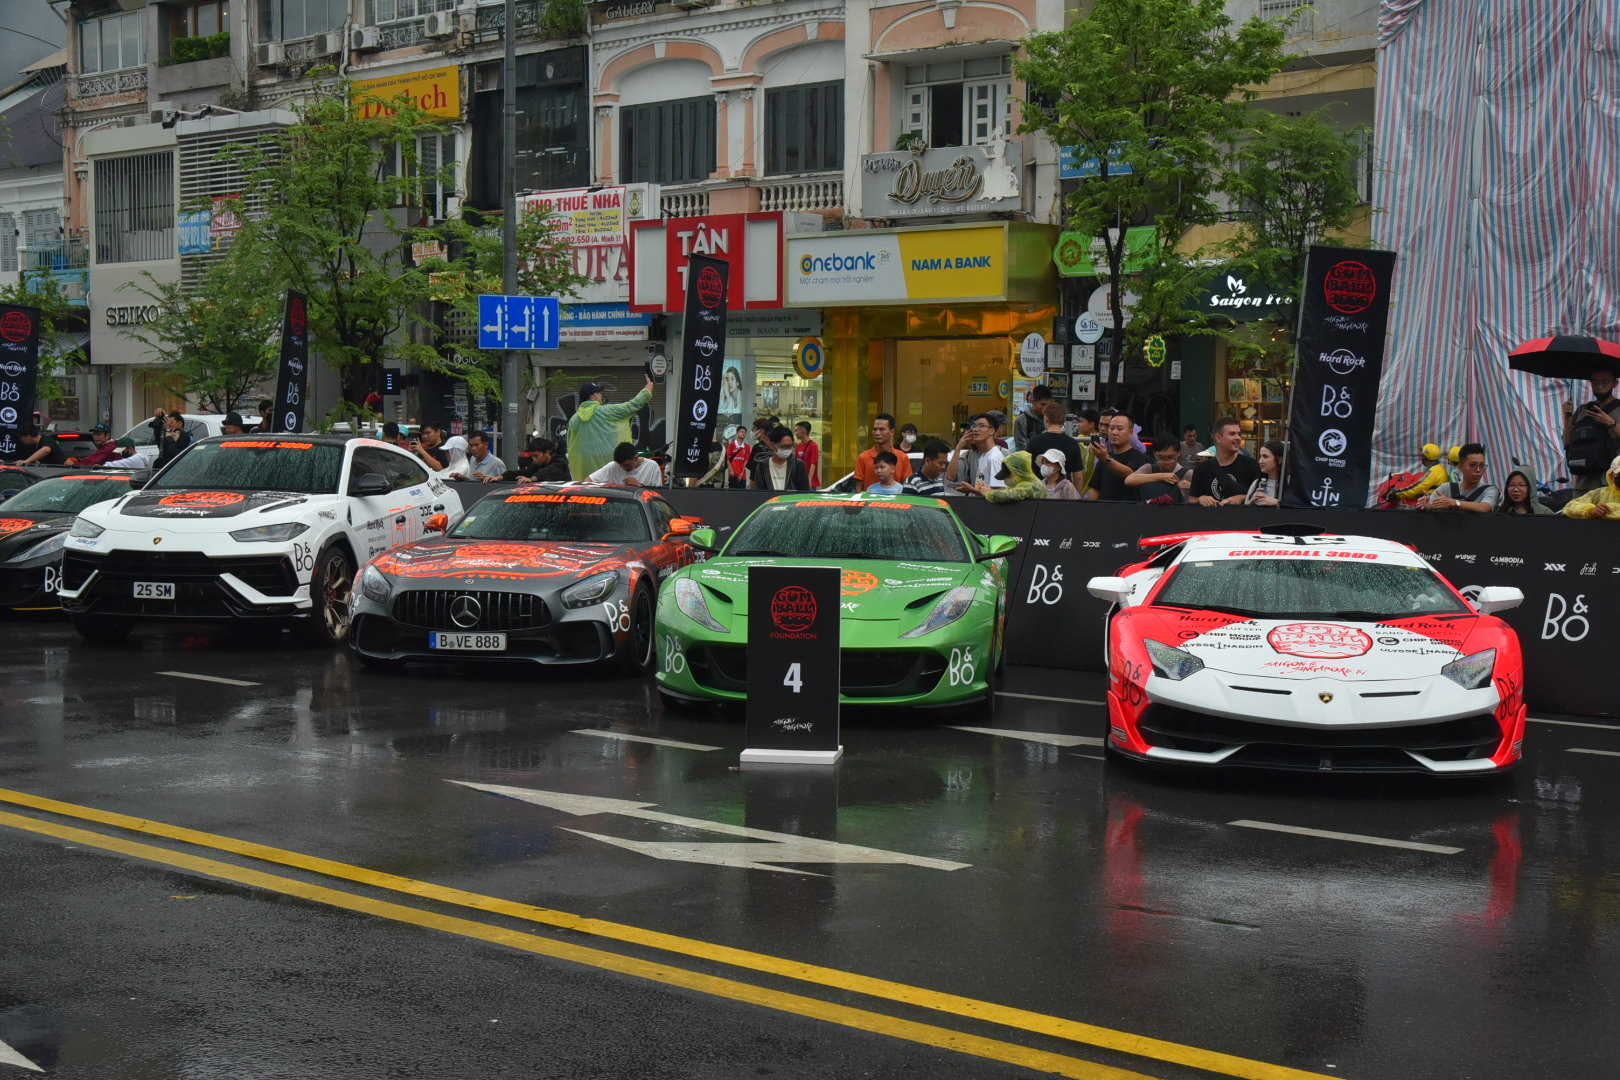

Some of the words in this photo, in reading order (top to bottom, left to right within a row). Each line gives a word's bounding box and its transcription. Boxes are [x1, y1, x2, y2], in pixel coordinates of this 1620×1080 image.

[606, 1, 655, 20] GALLERY
[527, 198, 552, 214] CHO
[556, 192, 588, 212] THUÊ
[593, 190, 620, 210] NHÀ
[677, 222, 728, 256] TÂN
[912, 259, 942, 271] NAM
[944, 258, 952, 270] A
[955, 256, 992, 268] BANK
[800, 276, 811, 286] Một
[812, 278, 830, 286] chạm
[830, 277, 842, 286] mọi
[853, 274, 875, 285] nghiệm
[1210, 292, 1262, 308] Saigon
[106, 305, 160, 326] SEIKO
[579, 310, 590, 320] BẢO
[592, 309, 607, 320] HÀNH
[608, 308, 625, 319] CHÍNH
[1319, 352, 1342, 364] Hard
[1343, 355, 1366, 368] Rock
[972, 383, 988, 392] 570
[505, 495, 566, 503] GUMBALL
[566, 496, 606, 505] 3000
[868, 502, 912, 510] 3000
[1326, 550, 1379, 560] 3000
[136, 584, 152, 596] 25
[156, 584, 172, 597] SM
[1222, 618, 1258, 626] Rock
[440, 634, 448, 647] B
[456, 636, 472, 648] VE
[476, 636, 500, 648] 888
[784, 662, 802, 692] 4
[1292, 666, 1353, 677] SINGAPORE
